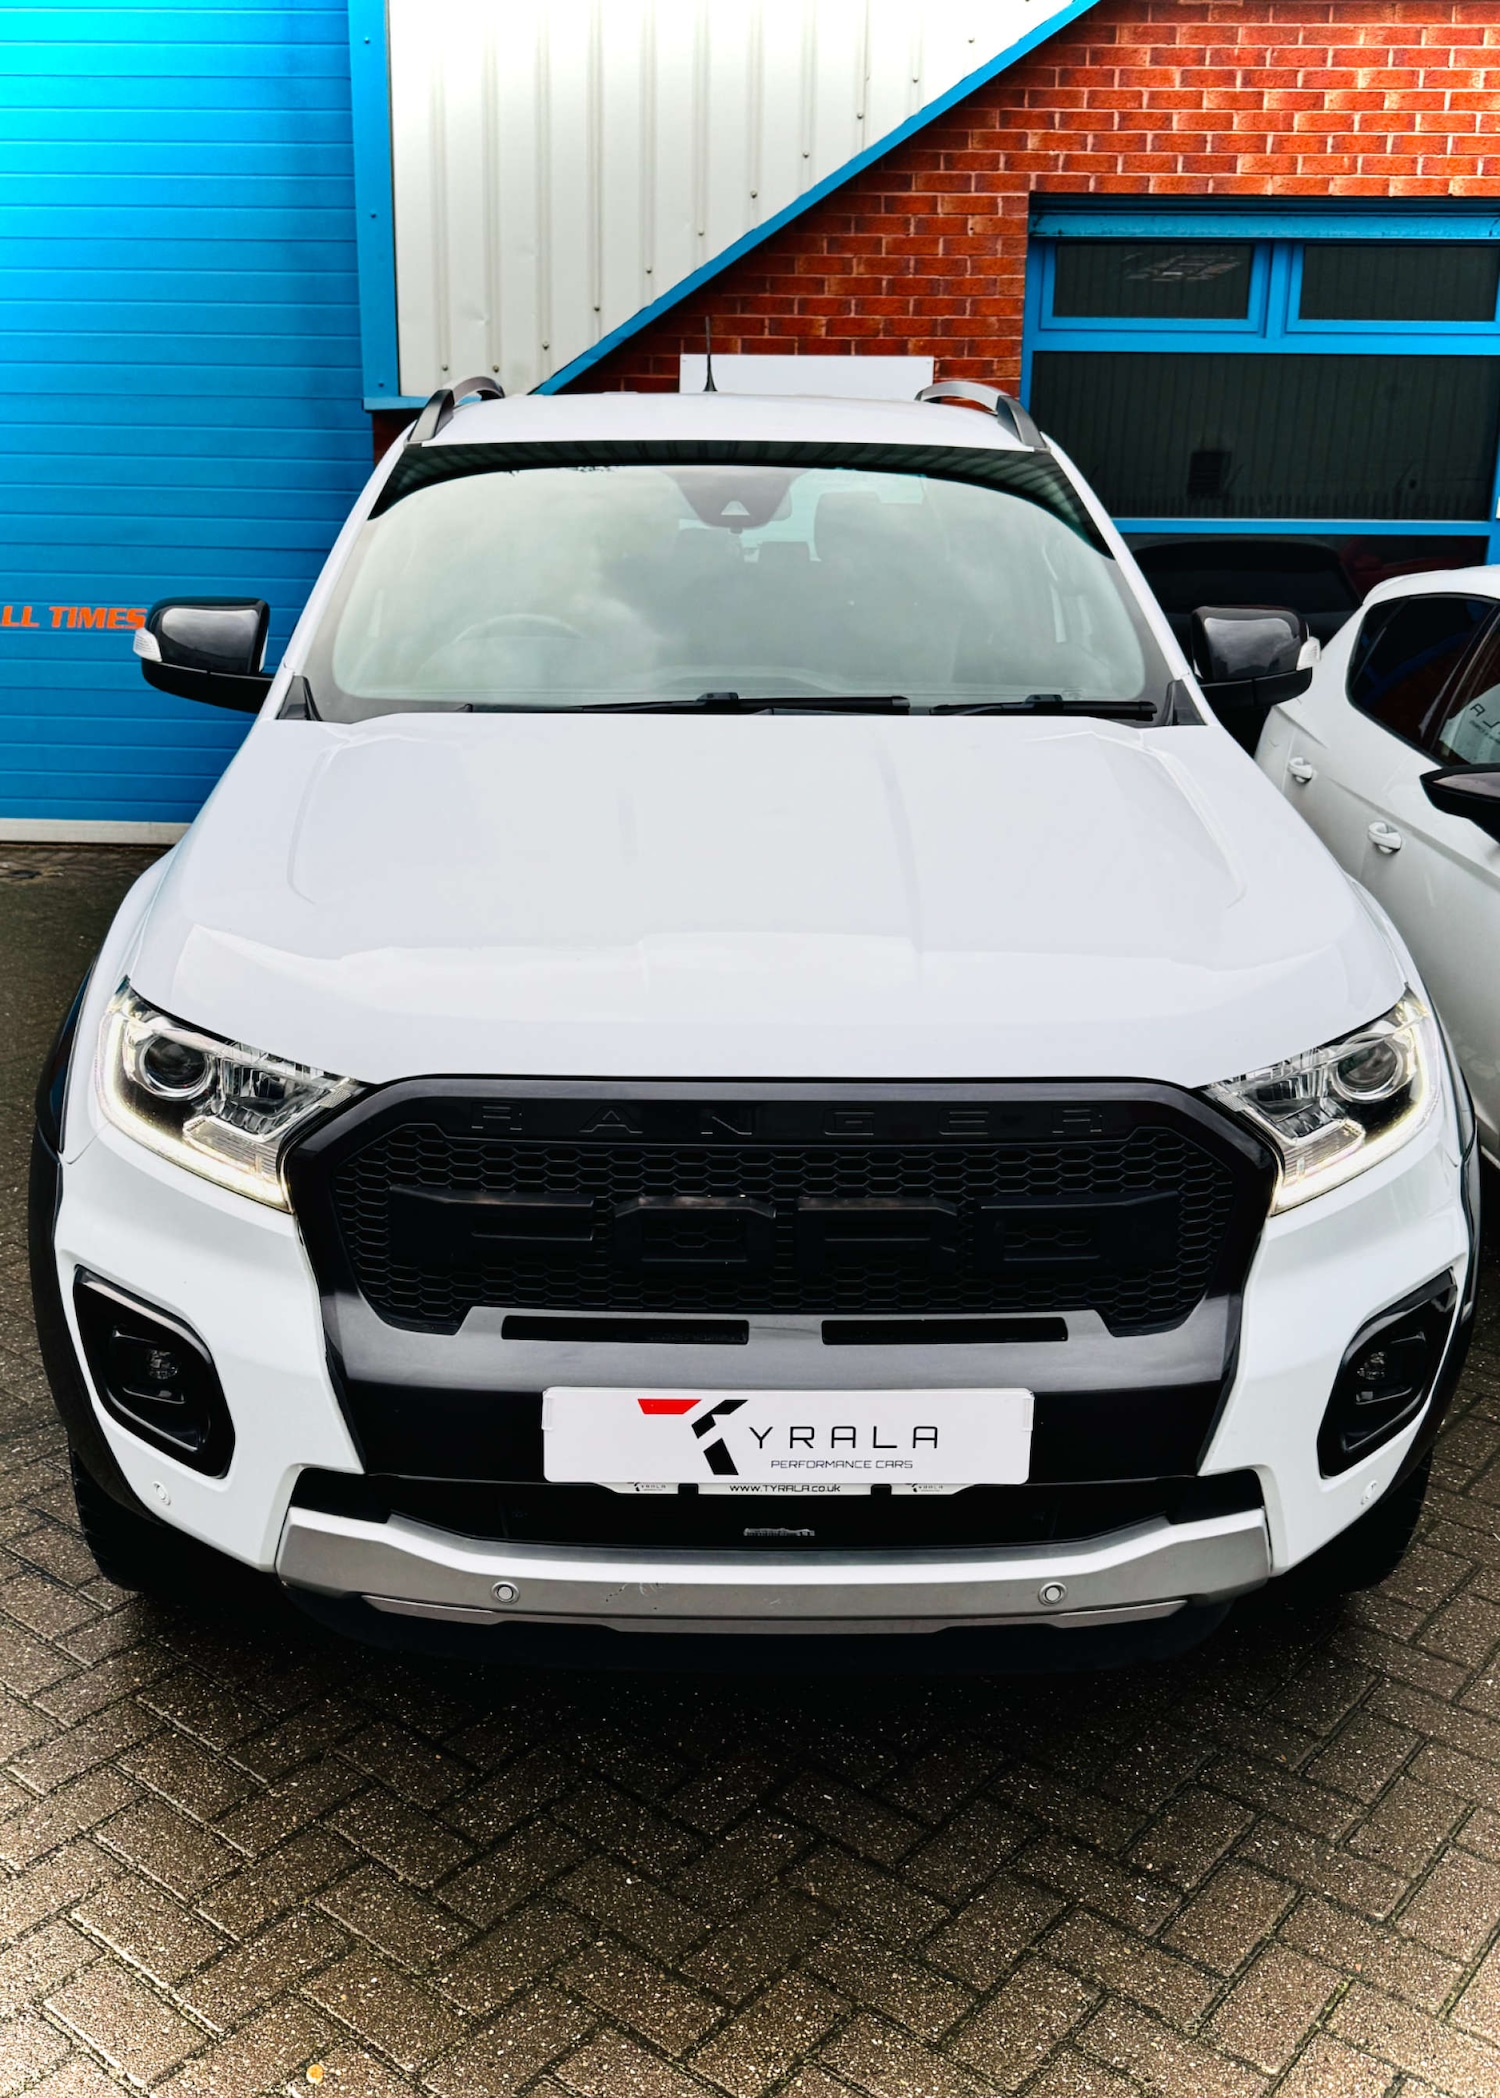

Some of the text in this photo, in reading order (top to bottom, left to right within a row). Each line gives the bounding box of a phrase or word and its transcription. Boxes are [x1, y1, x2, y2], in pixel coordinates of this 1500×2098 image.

[0, 605, 148, 629] LL TIMES
[470, 1103, 1103, 1134] RANGER
[390, 1187, 1180, 1268] FORD
[770, 1460, 913, 1469] PERFORMANCE CARS
[729, 1484, 842, 1493] www.TYRALA.co.uk
